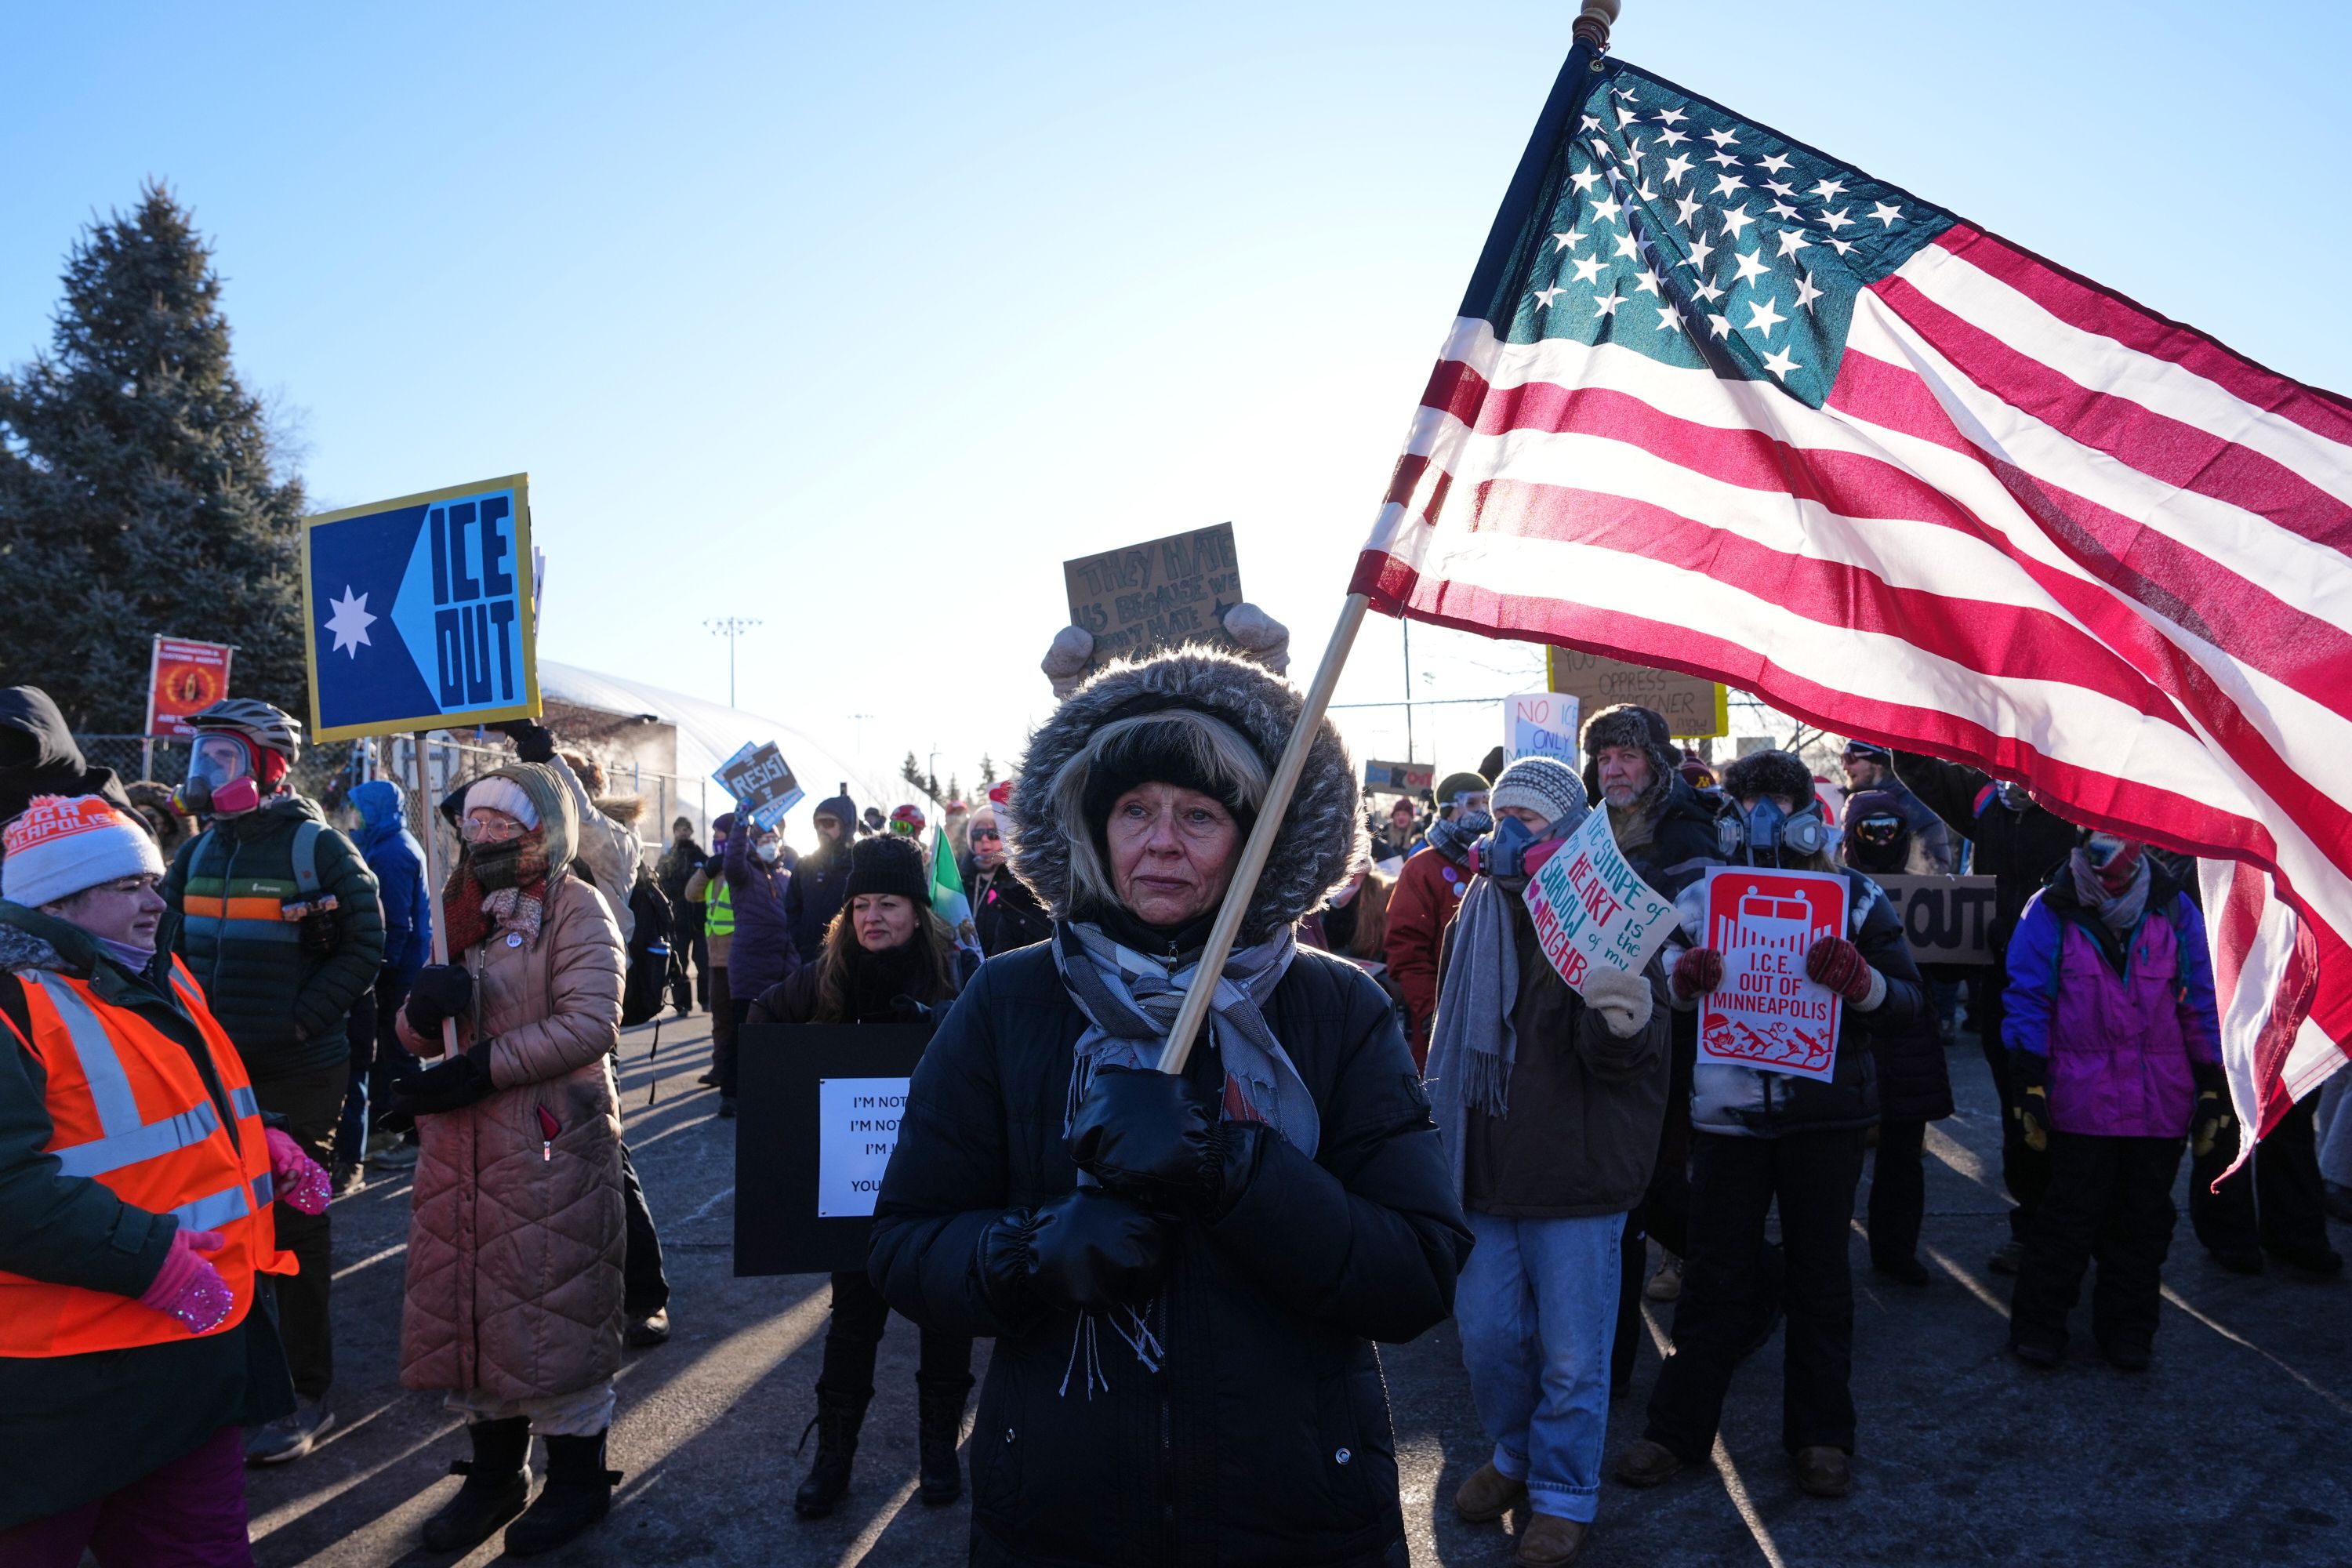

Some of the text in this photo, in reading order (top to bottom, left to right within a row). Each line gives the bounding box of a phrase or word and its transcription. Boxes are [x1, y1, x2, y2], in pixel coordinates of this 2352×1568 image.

[430, 496, 513, 606] ICE
[1077, 528, 1237, 596] THEY HATE
[1073, 572, 1239, 632] US BECAUSE WE
[1147, 606, 1203, 640] HATE
[435, 600, 514, 708] OUT
[1599, 671, 1666, 695] OPPRESS
[1517, 700, 1549, 724] NO
[1562, 703, 1577, 728] ICE
[1534, 729, 1570, 753] ONLY
[731, 752, 789, 798] RESIST
[1563, 832, 1580, 858] my
[1587, 810, 1670, 925] the SHAPE of
[1569, 851, 1622, 927] HEART
[1541, 855, 1629, 971] SHADOW of my
[1905, 887, 1995, 951] OUT
[1617, 934, 1641, 956] the
[1751, 953, 1793, 975] I.C.E.
[1740, 974, 1802, 996] OUT OF
[1713, 993, 1828, 1021] MINNEAPOLIS
